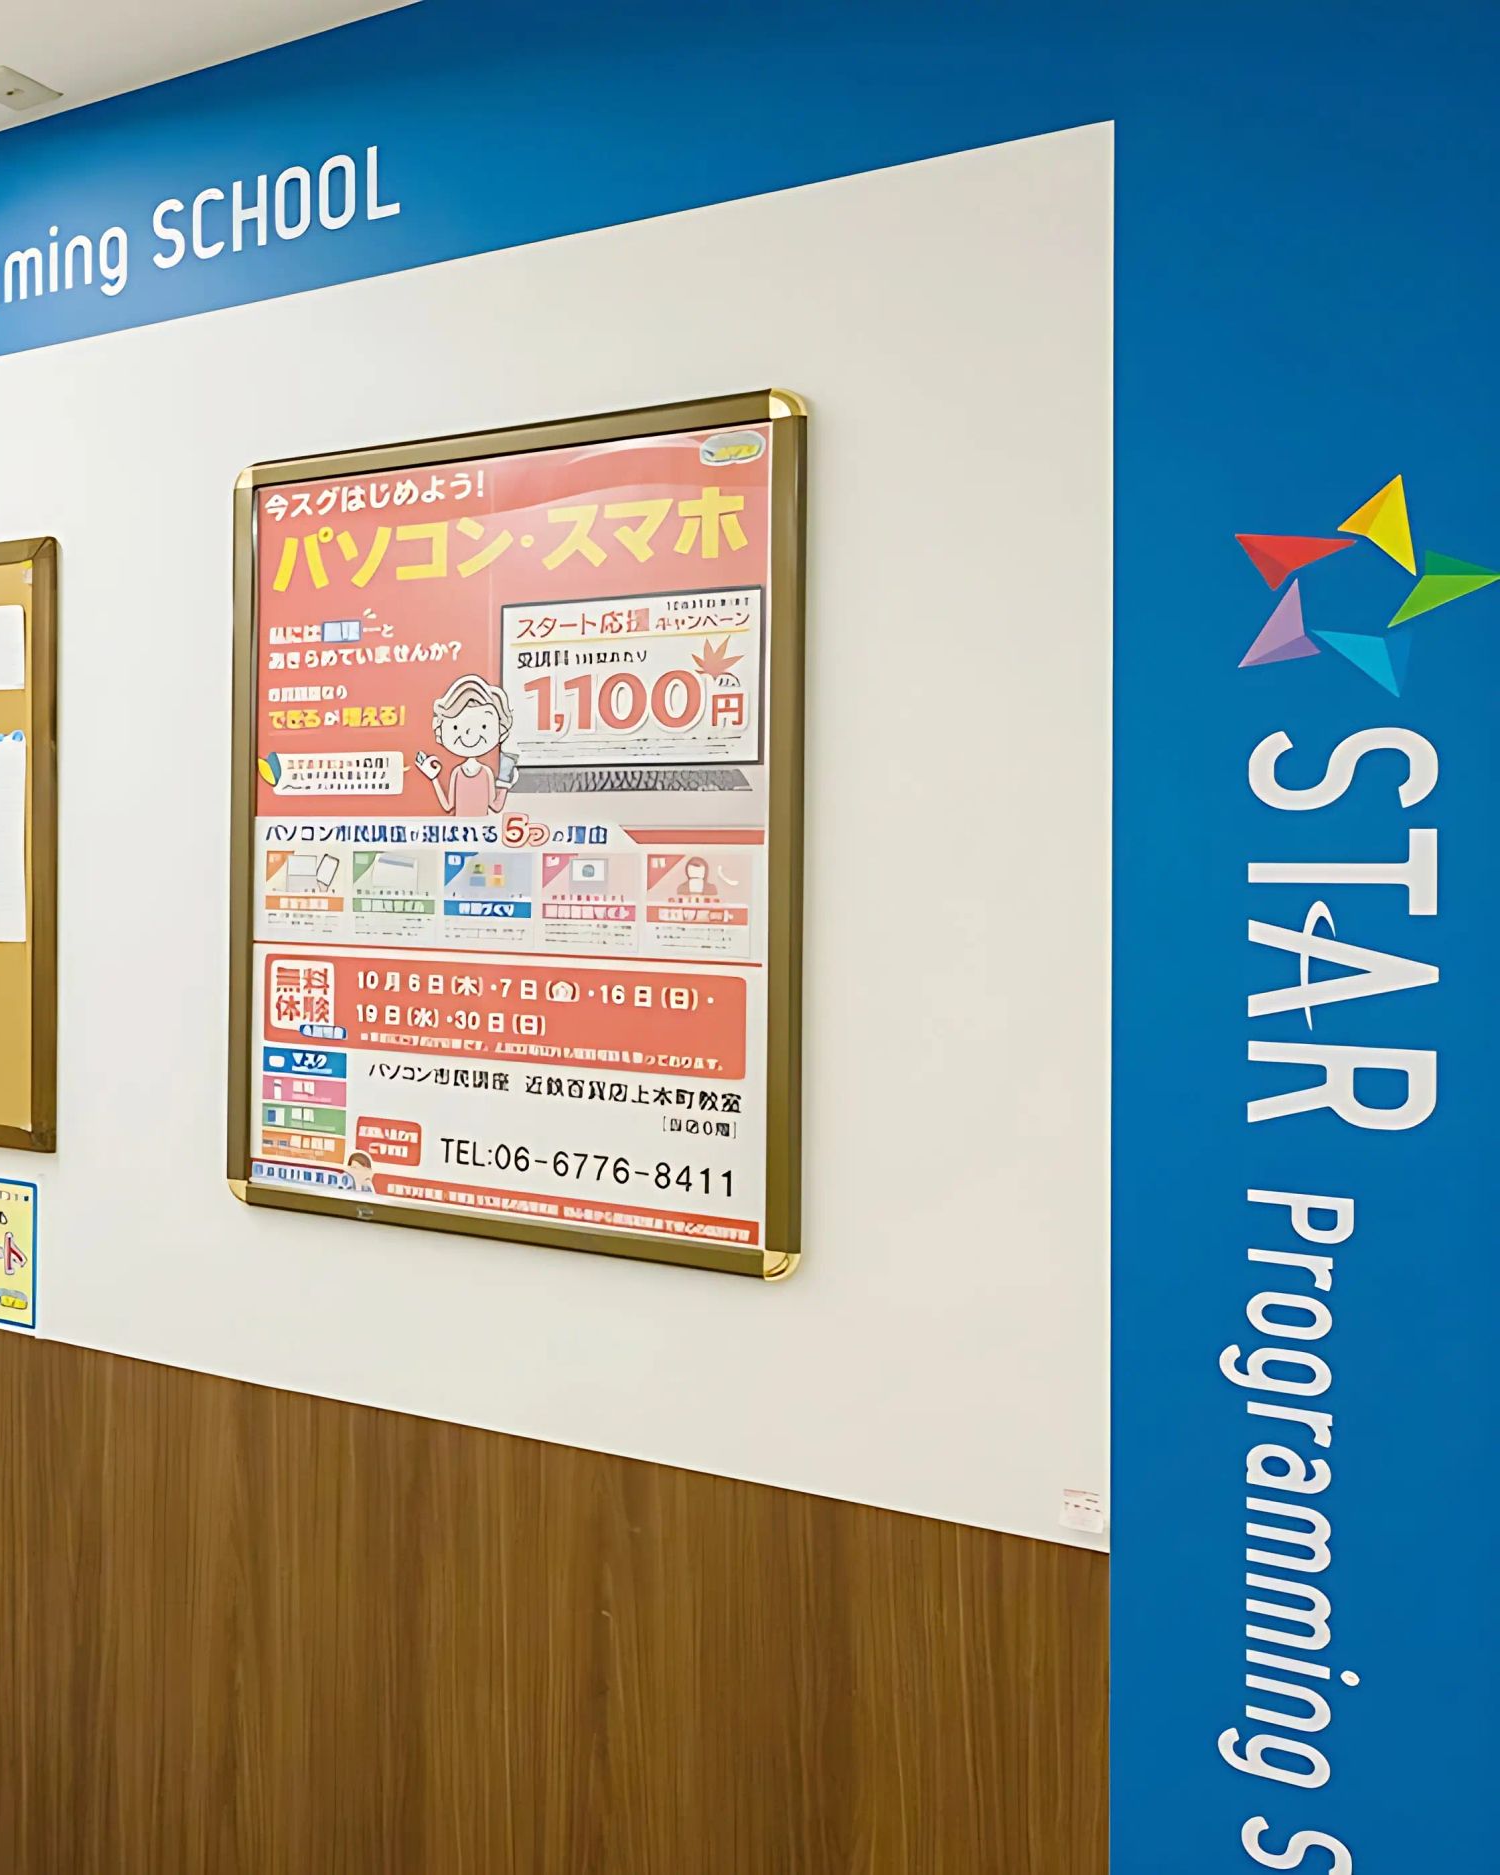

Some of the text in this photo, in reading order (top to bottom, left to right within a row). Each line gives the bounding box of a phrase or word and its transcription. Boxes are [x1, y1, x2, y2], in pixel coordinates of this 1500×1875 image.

[152, 145, 401, 271] SCHOOL
[272, 486, 749, 592] パソコン・スマホ
[1247, 727, 1440, 1130] STAR
[440, 1136, 734, 1198] TEL:06-6776-8411
[1218, 1189, 1360, 1790] Programming
